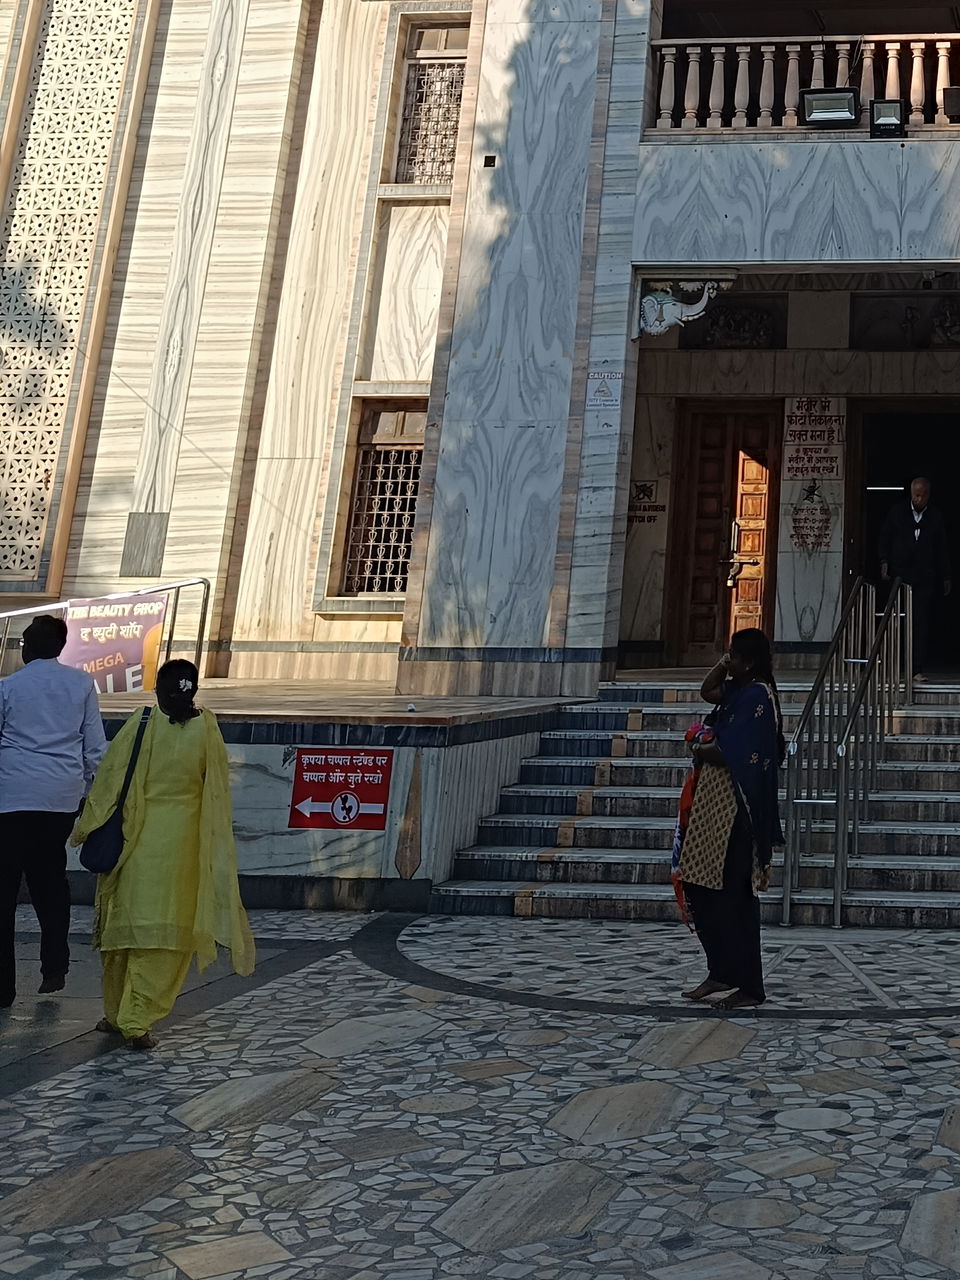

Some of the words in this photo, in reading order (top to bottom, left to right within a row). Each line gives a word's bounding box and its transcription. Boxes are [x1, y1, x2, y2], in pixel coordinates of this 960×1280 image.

[810, 429, 826, 441] मना
[646, 515, 657, 523] OFF
[68, 606, 89, 620] THE
[89, 603, 132, 618] BEAUTY
[133, 601, 164, 616] SHOP
[80, 627, 92, 641] द
[120, 621, 143, 639] शॉप
[83, 652, 124, 673] MEGA
[301, 754, 325, 770] कृपया
[327, 755, 351, 766] चप्पल
[375, 756, 388, 767] पर
[302, 772, 327, 783] चप्पल
